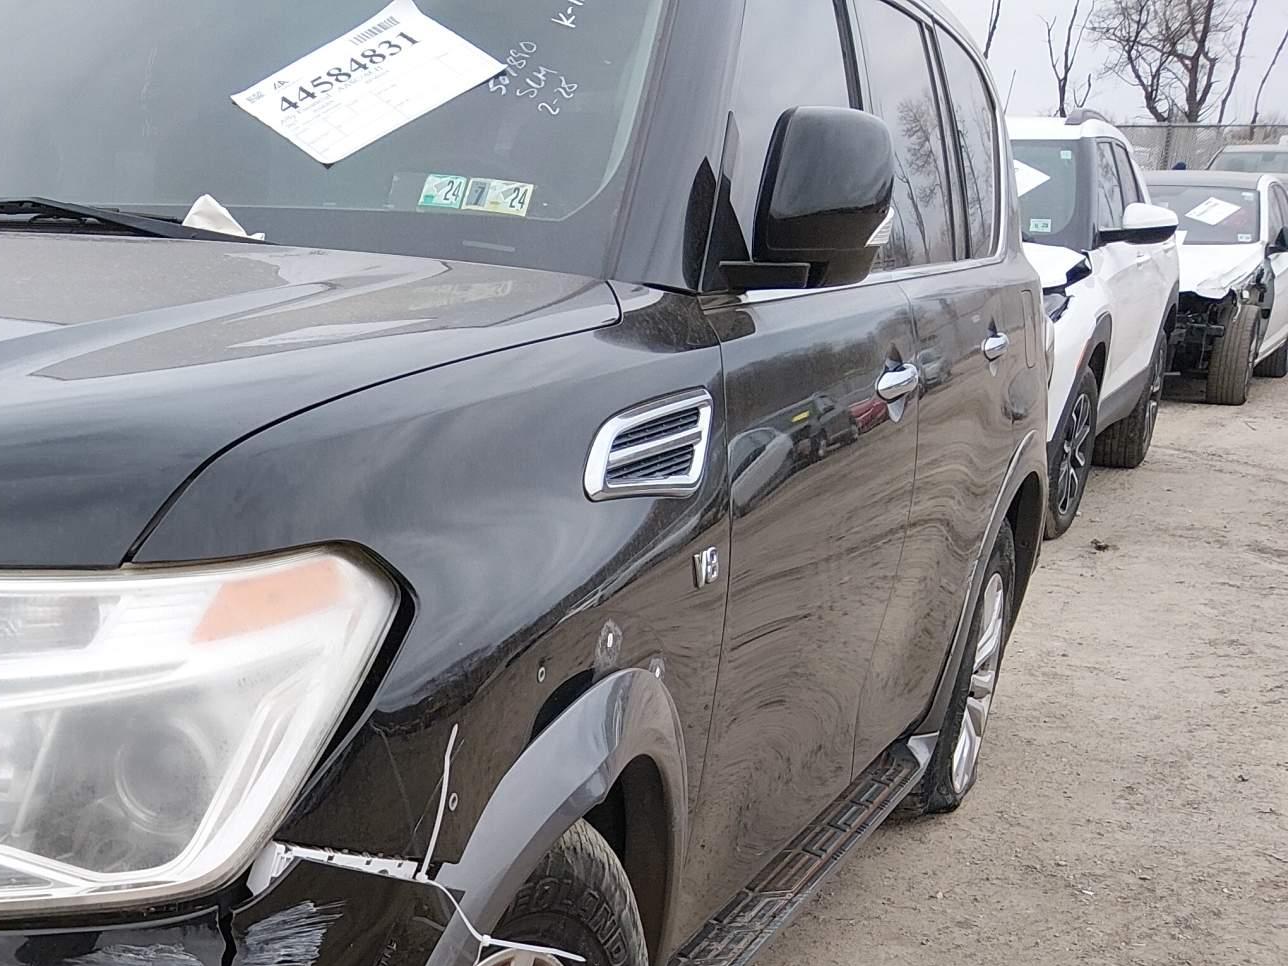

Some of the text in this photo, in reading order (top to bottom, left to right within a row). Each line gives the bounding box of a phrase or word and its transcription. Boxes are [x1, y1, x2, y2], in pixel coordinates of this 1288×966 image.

[280, 31, 421, 112] 44584831
[443, 180, 463, 202] 24
[508, 186, 530, 210] 24
